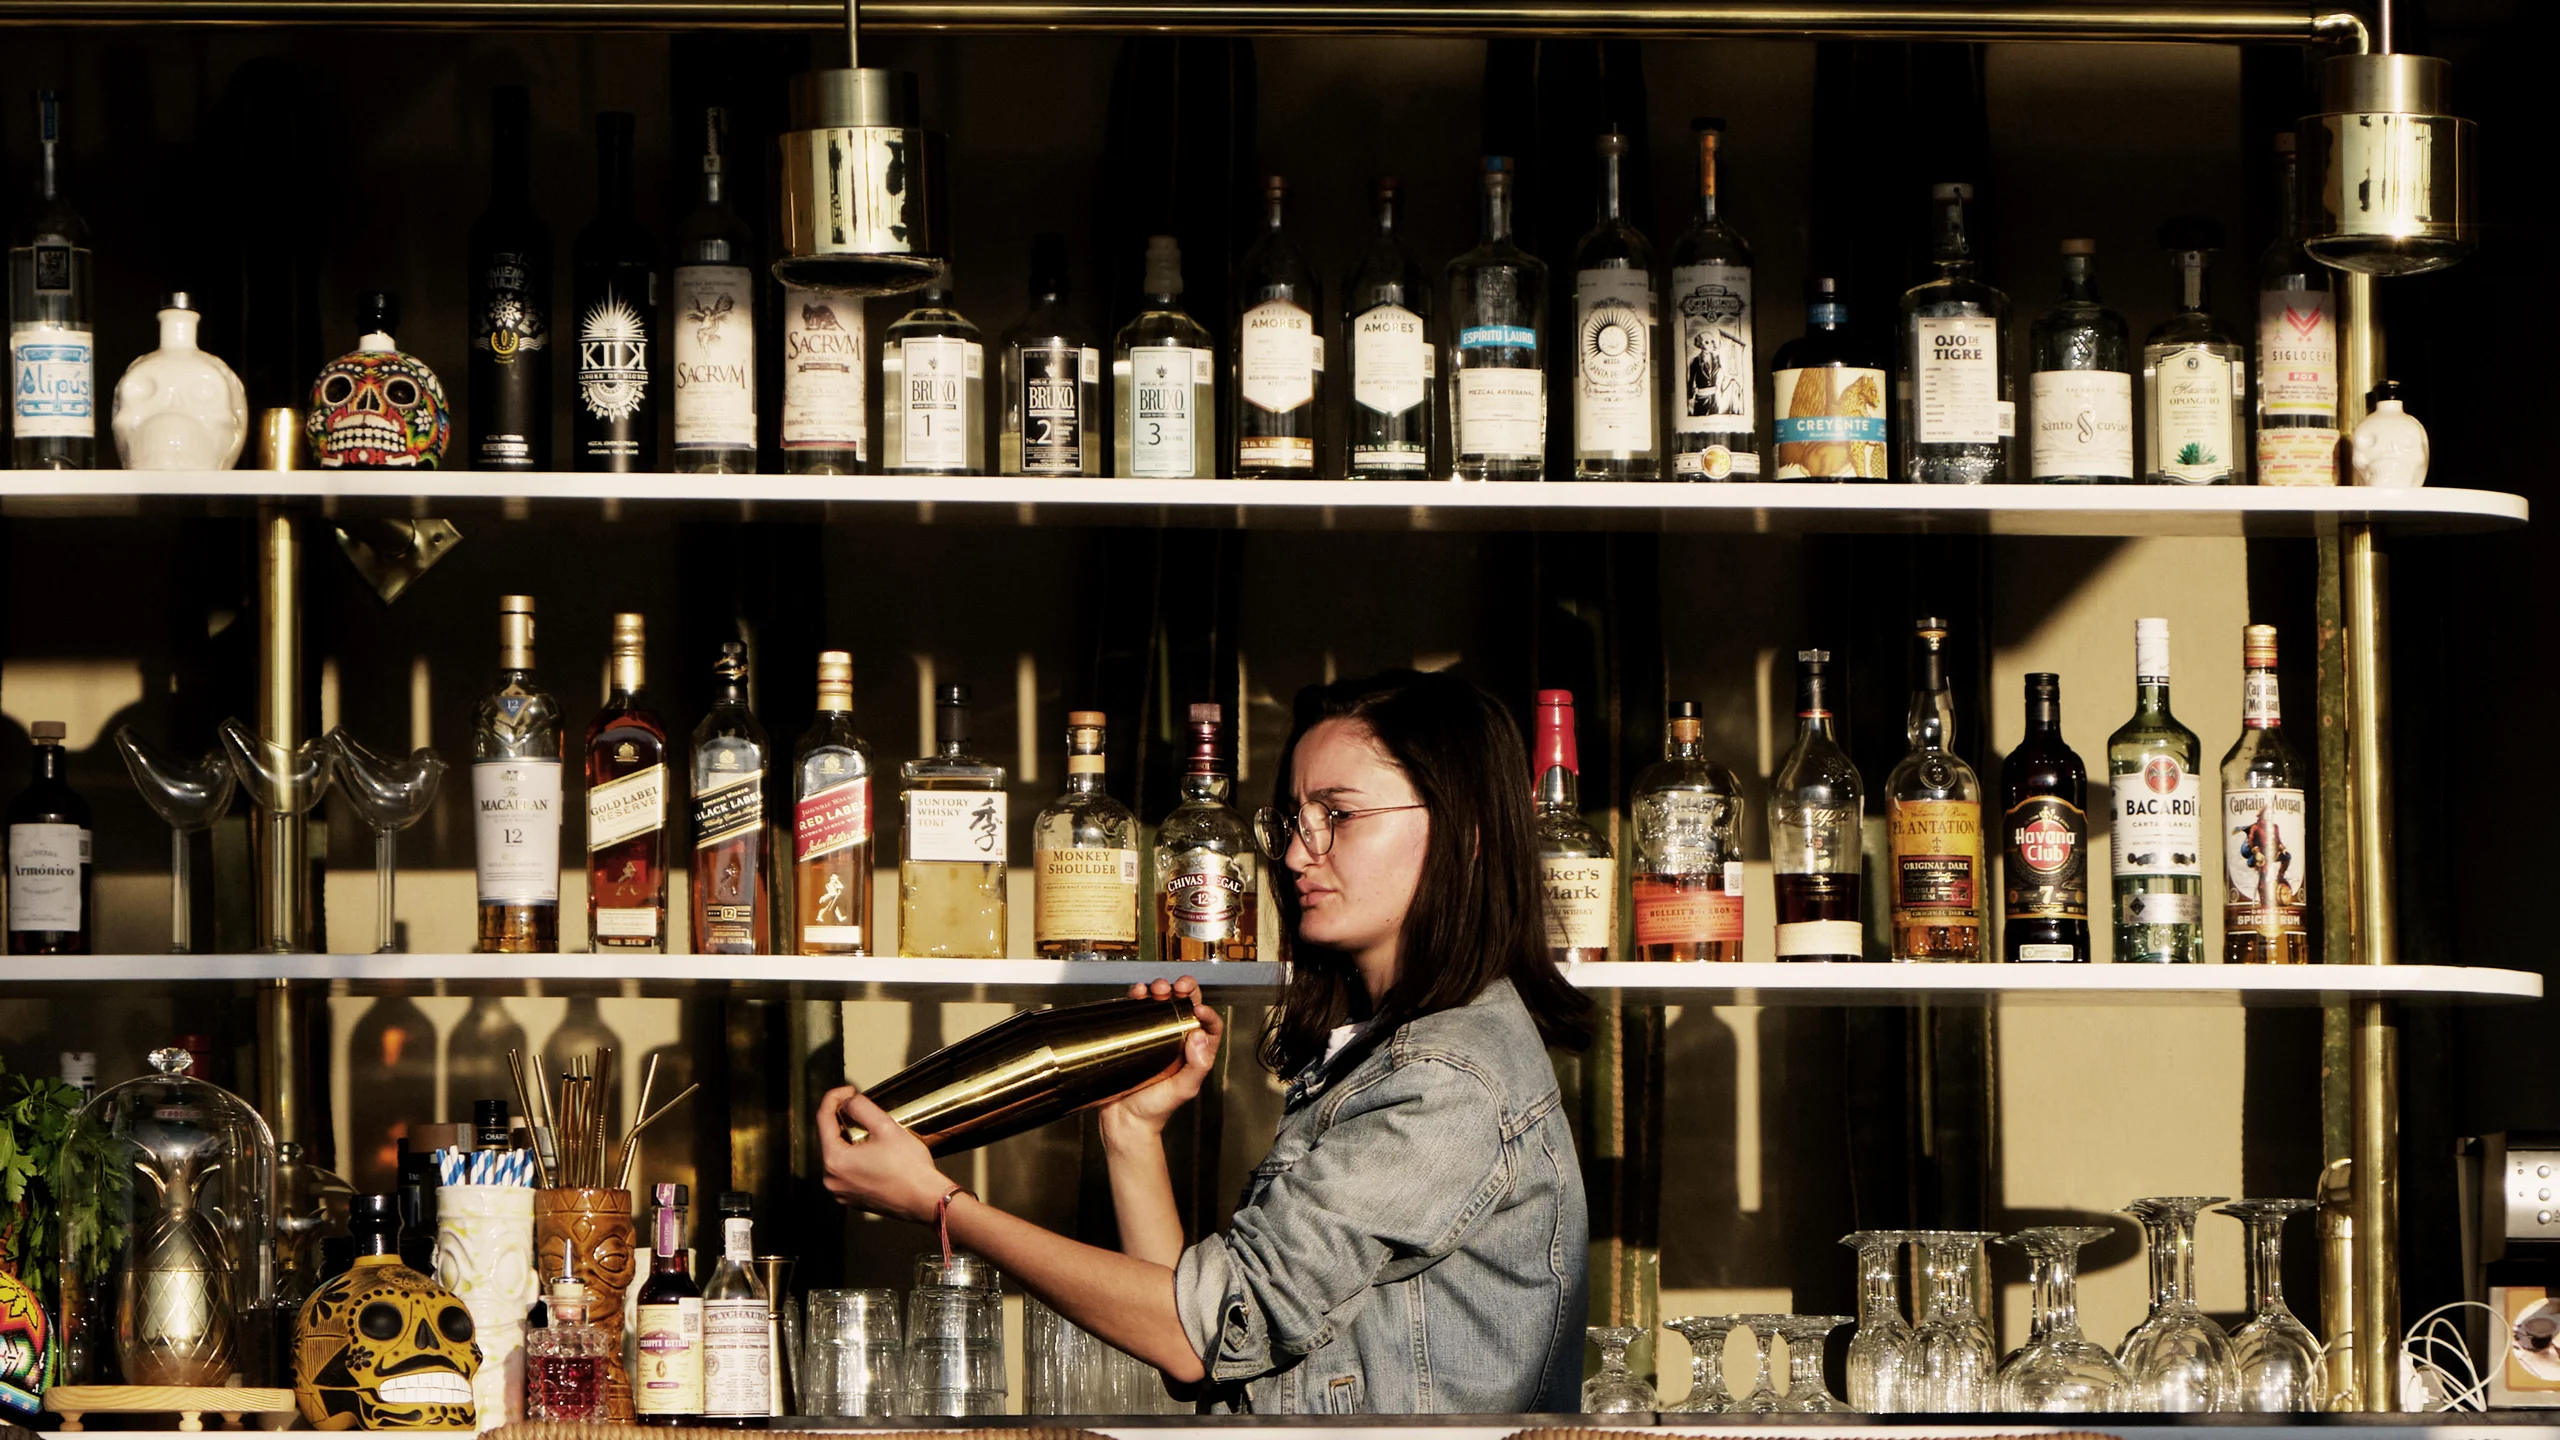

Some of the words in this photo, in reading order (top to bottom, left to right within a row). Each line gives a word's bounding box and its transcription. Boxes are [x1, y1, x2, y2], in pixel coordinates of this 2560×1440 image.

[1251, 319, 1302, 329] AMORES
[1364, 323, 1414, 333] AMORES
[1463, 327, 1502, 345] ESPÍRITU
[1504, 330, 1533, 344] LAURO
[1935, 335, 1966, 346] OJO
[1969, 336, 1980, 345] DE
[788, 332, 861, 361] SACRVM
[1934, 349, 1982, 360] TIGRE
[17, 364, 88, 404] Alipús
[678, 363, 746, 389] SACRVM
[911, 380, 956, 402] BRUXO
[1029, 387, 1075, 409] BRUXO
[1139, 389, 1185, 411] BRUXO
[922, 414, 931, 437] 1
[1037, 419, 1054, 445] 2
[1796, 419, 1869, 431] CREYENTE
[2041, 420, 2073, 432] santo
[1148, 422, 1161, 446] 3
[507, 700, 519, 709] 12
[591, 799, 621, 816] GOLD
[623, 786, 659, 805] LABEL
[918, 798, 970, 807] SUNTORY
[2126, 795, 2195, 816] BACARDÍ
[2229, 795, 2265, 815] Captain
[598, 797, 657, 824] RESERVE
[799, 815, 824, 831] RED
[826, 800, 866, 821] LABEL
[918, 808, 961, 817] WHISKY
[918, 818, 944, 827] TOKI
[1893, 820, 1975, 835] PLANTATION
[504, 828, 523, 844] 12
[2015, 827, 2076, 845] Havana
[1053, 850, 1110, 862] MONKEY
[2027, 845, 2064, 861] Club
[14, 863, 74, 876] Armónico
[1048, 864, 1116, 875] SHOULDER
[1903, 862, 1945, 871] ORIGINAL
[1948, 862, 1969, 871] DARK
[1167, 873, 1204, 892] CHIVAS
[1205, 873, 1242, 893] EGAL
[1197, 892, 1209, 905] 12
[2039, 885, 2055, 905] 7
[724, 909, 735, 918] 12
[1650, 908, 1686, 918] BULLEIT
[2238, 915, 2273, 926] SPICE
[2278, 916, 2300, 926] RUM
